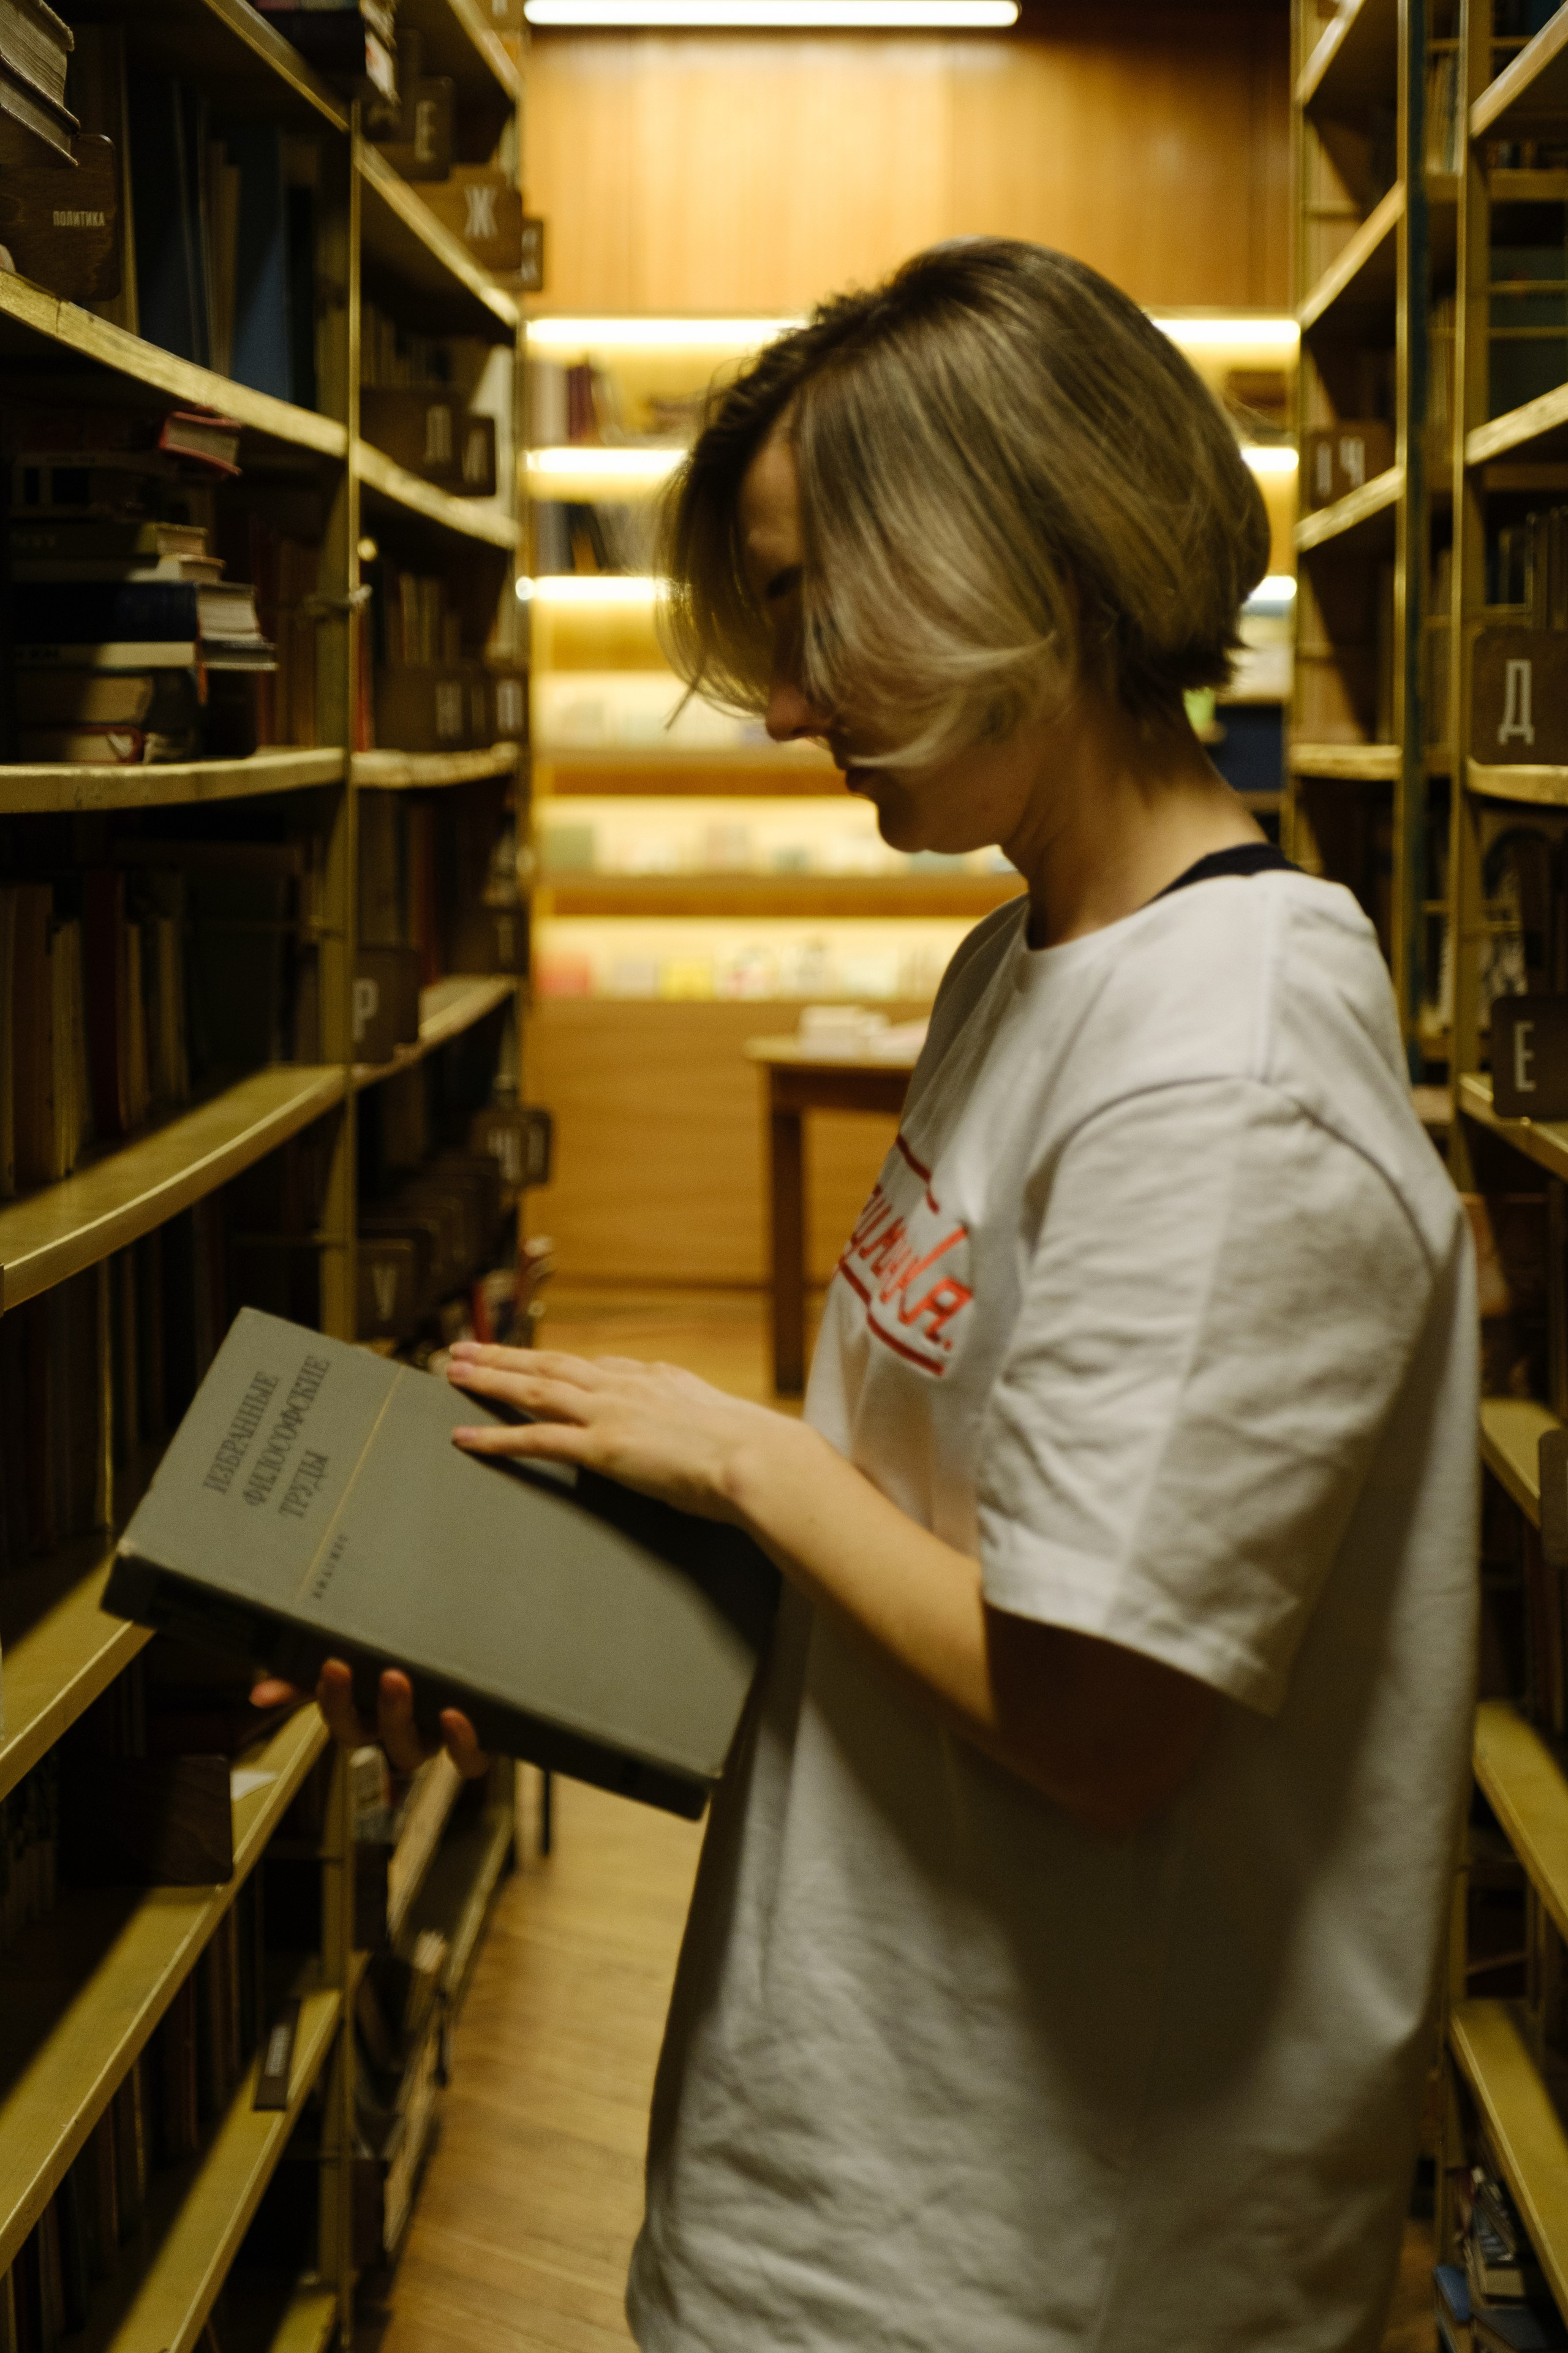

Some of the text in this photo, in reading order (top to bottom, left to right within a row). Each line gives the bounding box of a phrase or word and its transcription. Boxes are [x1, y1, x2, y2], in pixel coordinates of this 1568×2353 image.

[53, 210, 105, 227] ПОЛИТИКА
[464, 184, 498, 240] Ж
[1498, 658, 1536, 746] Д
[1514, 1019, 1537, 1088] Е
[202, 1371, 279, 1495] ИЗБРАННЫЕ
[243, 1355, 330, 1506] ФИЛОСОФСКИЕ
[278, 1449, 329, 1518] ТРУДЫ
